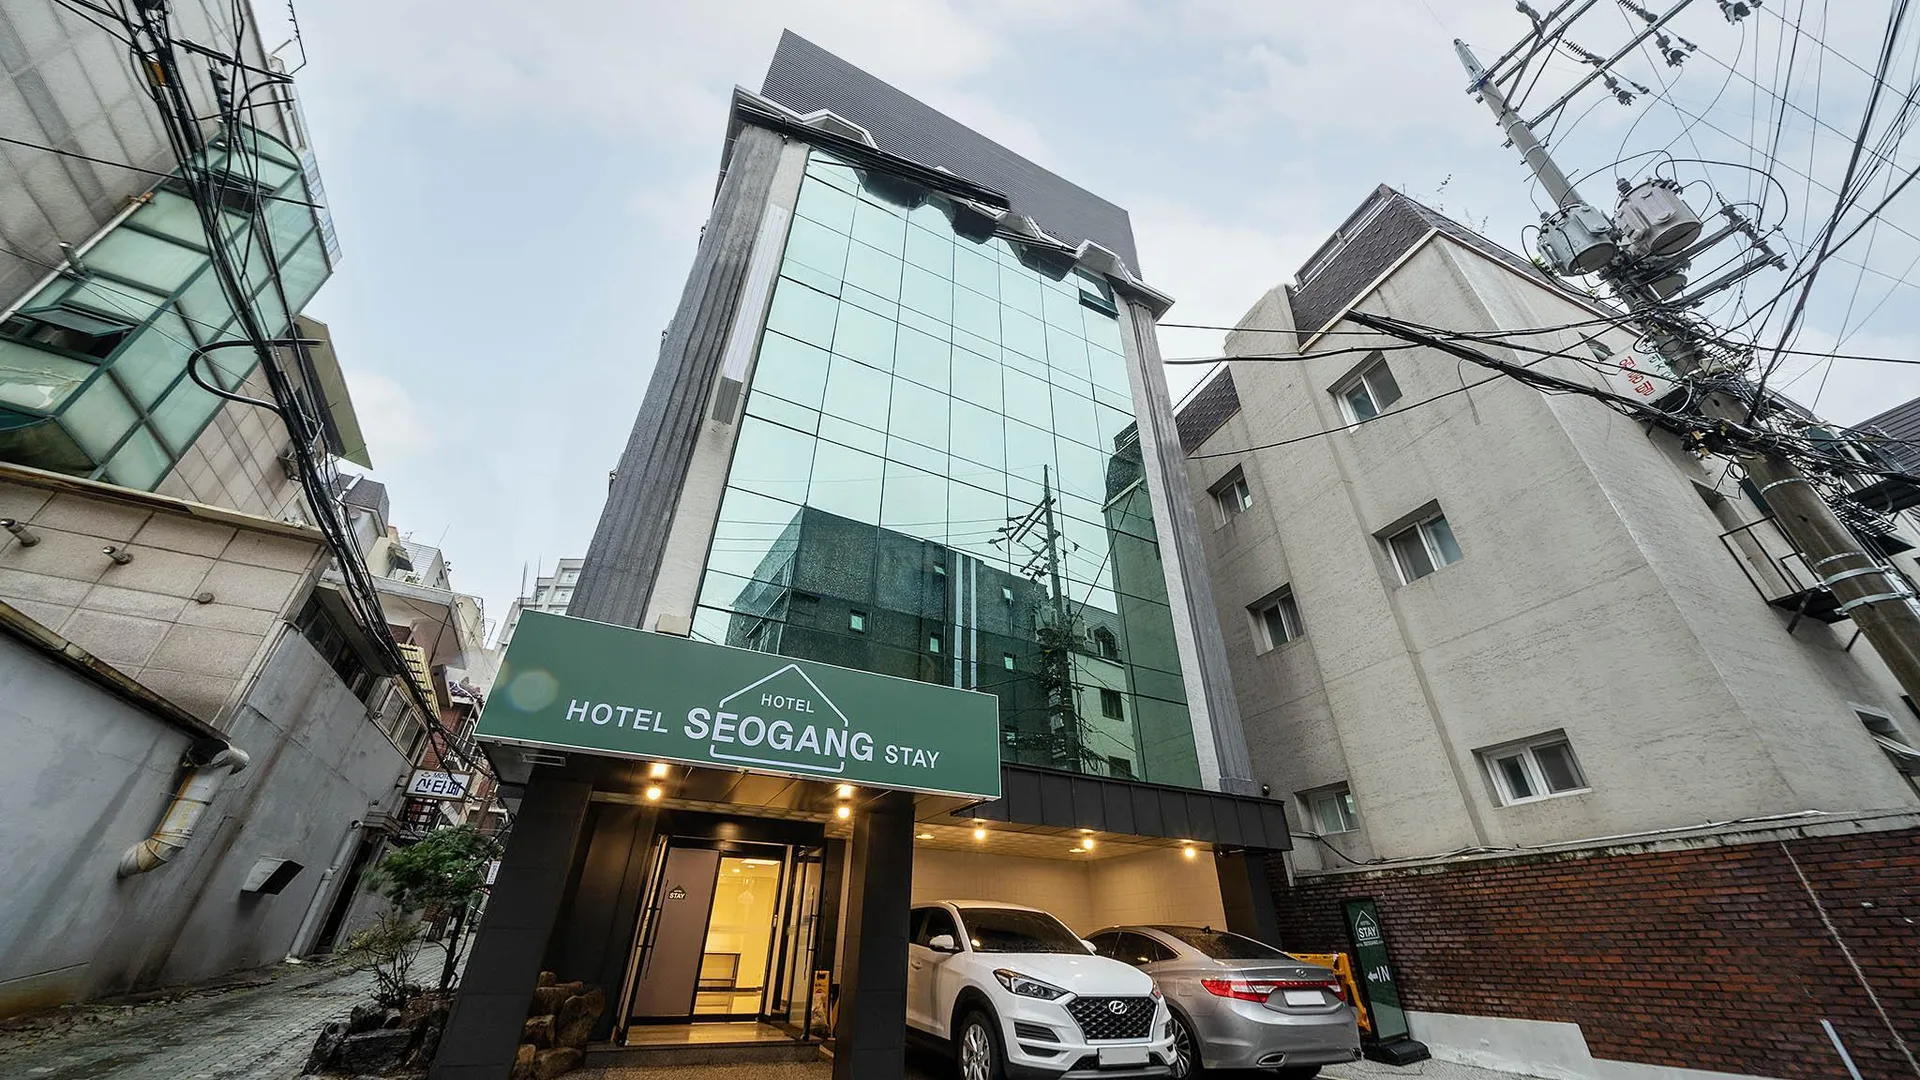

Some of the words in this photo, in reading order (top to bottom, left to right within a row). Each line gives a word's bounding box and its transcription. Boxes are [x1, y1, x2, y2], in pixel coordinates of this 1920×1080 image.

[761, 692, 815, 713] HOTEL
[565, 698, 668, 734] HOTEL
[684, 707, 875, 762] SEOGANG
[884, 743, 940, 769] STAY
[416, 778, 462, 795] 산타페
[1358, 926, 1376, 938] STAY
[1377, 964, 1391, 983] IN
